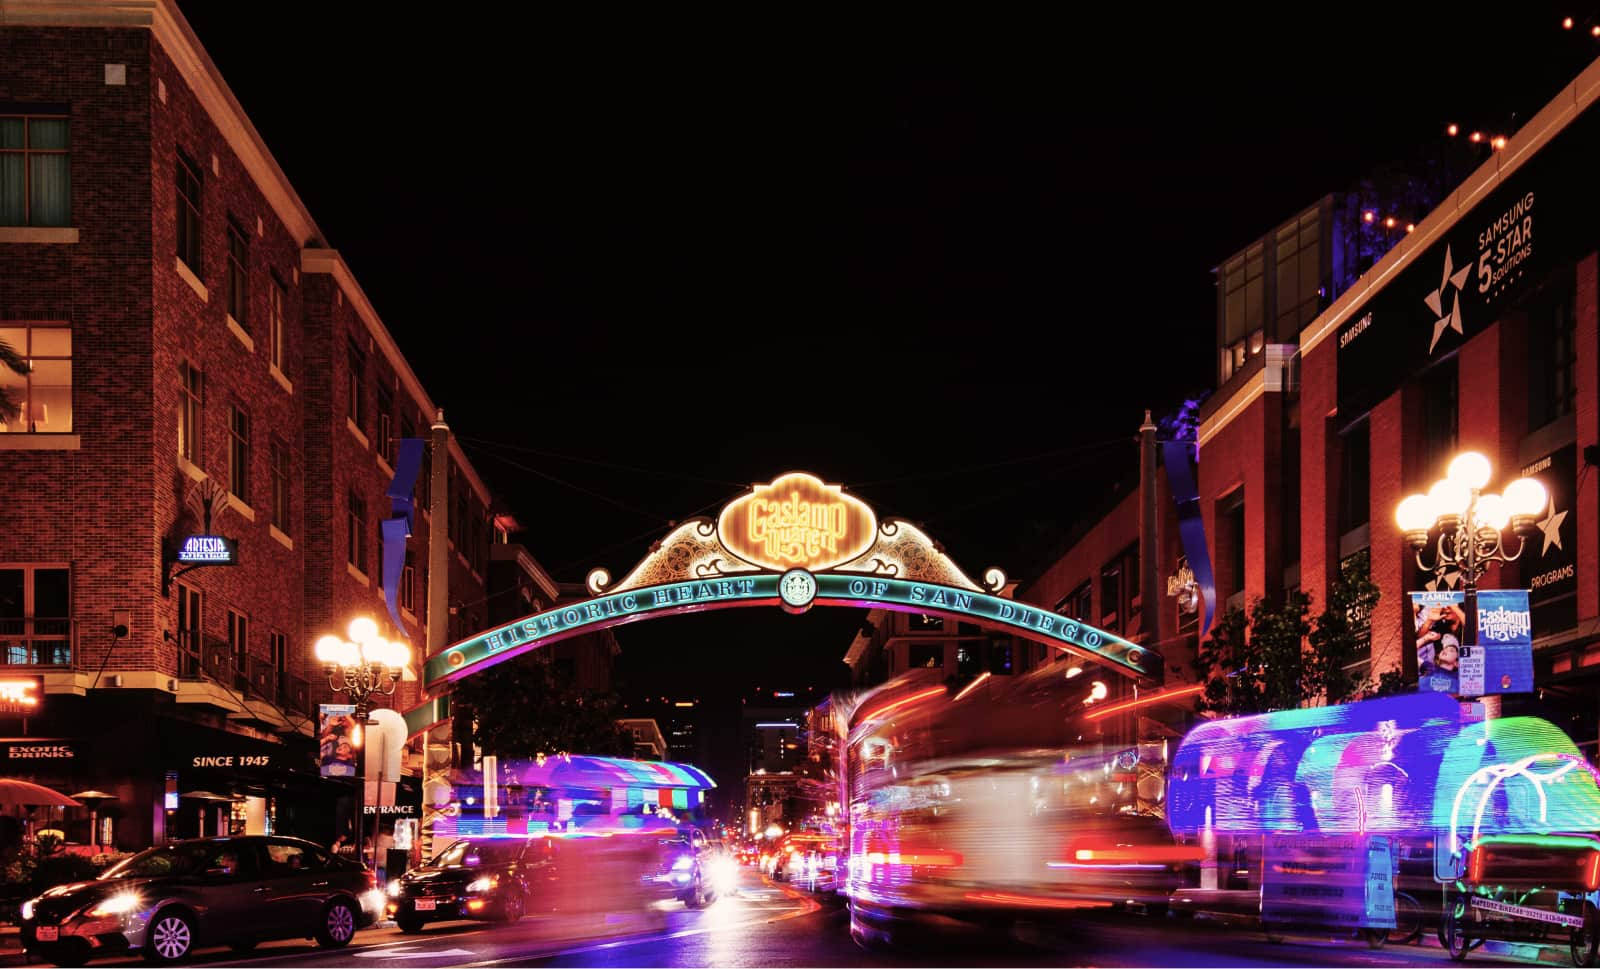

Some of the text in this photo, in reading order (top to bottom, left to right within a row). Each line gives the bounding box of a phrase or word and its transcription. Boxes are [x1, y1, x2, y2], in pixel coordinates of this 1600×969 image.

[1479, 192, 1534, 250] SAMSUNG
[1478, 216, 1532, 293] 5-STAR
[1493, 243, 1532, 284] SOLUTIONS
[1340, 311, 1372, 349] SAMSUNG
[748, 491, 847, 542] Gaslamp
[185, 538, 225, 552] ARTESIA
[765, 526, 838, 563] Quarter
[1531, 564, 1574, 588] PROGRAMS
[484, 578, 1103, 653] HISTORIC HEART OF SAN DIEGO
[1477, 605, 1531, 632] Gaslamp
[192, 755, 270, 767] SINCE 1945
[363, 805, 414, 815] ENRANCE
